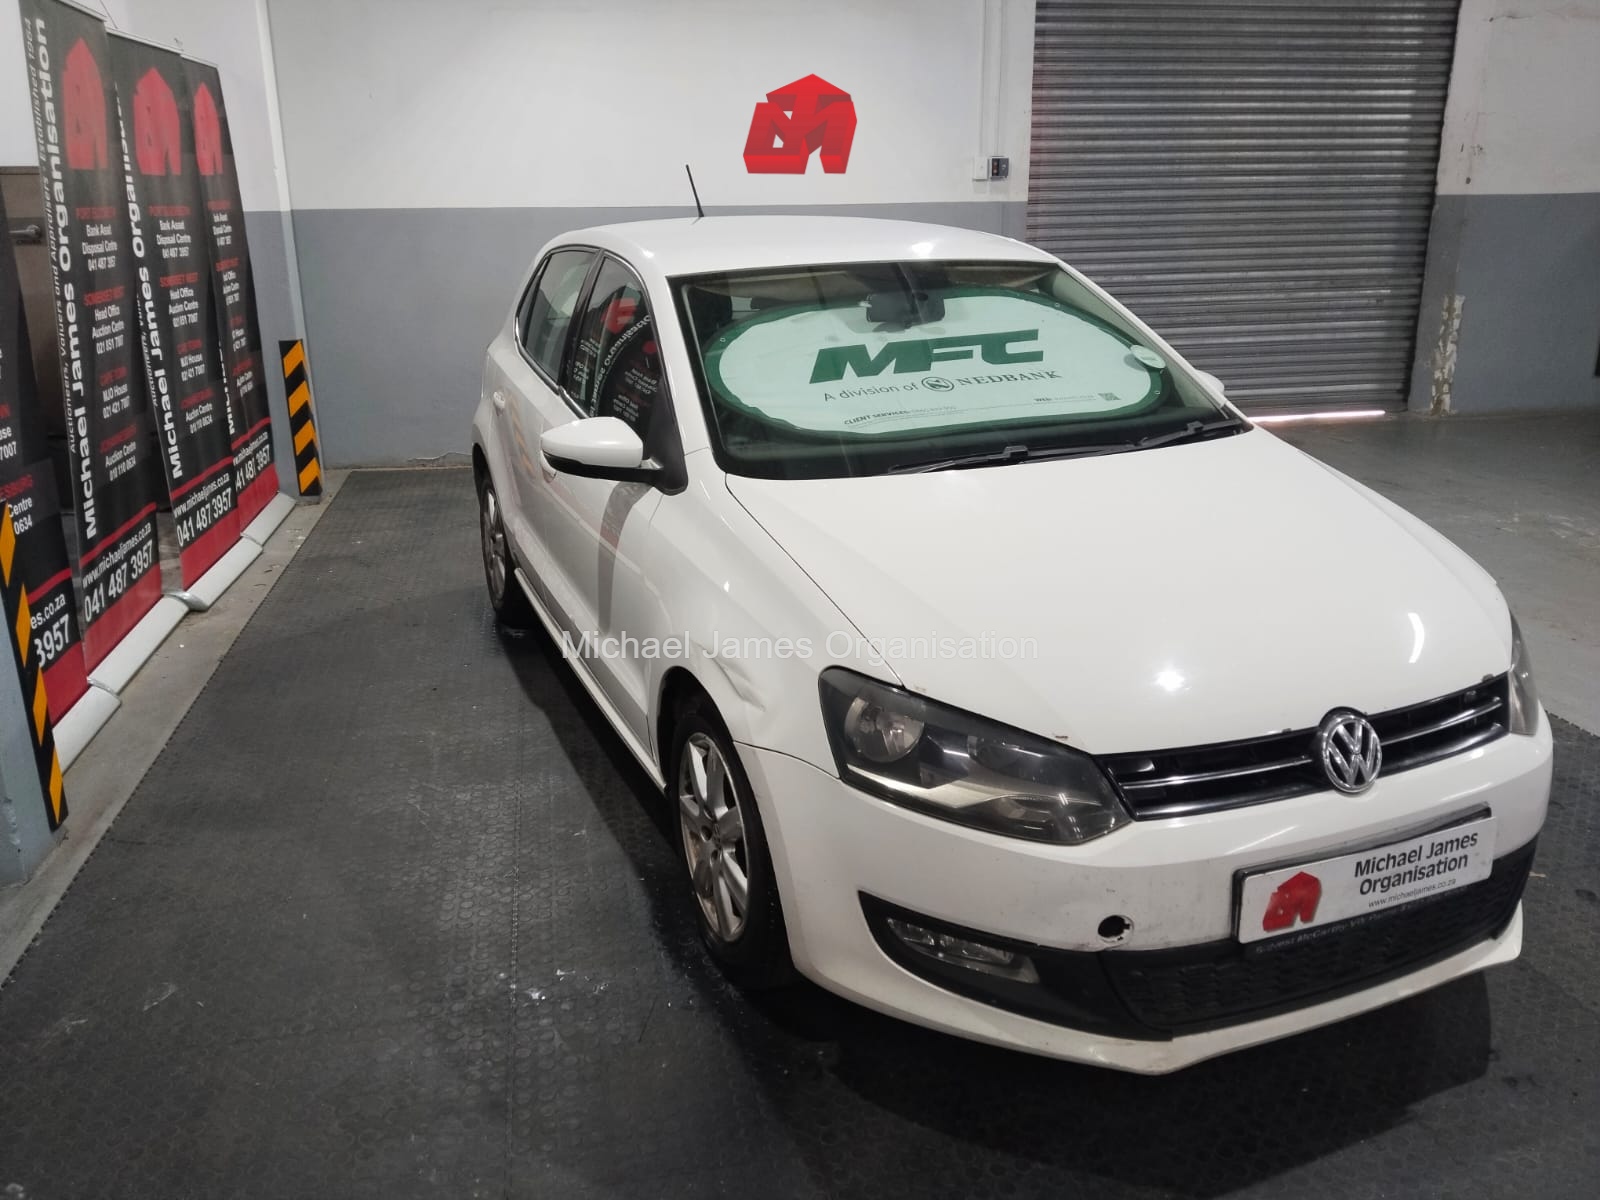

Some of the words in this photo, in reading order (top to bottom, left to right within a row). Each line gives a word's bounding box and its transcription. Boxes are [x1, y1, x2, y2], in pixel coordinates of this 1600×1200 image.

[35, 18, 71, 272] Organisation
[43, 176, 57, 262] Appraisers
[51, 266, 60, 296] and
[56, 301, 67, 357] Valuers
[63, 282, 84, 397] James
[139, 267, 163, 361] James
[809, 329, 1044, 384] MFC
[824, 392, 836, 402] A
[839, 383, 899, 400] division
[903, 382, 919, 393] of
[958, 371, 1062, 386] NEDBANK
[154, 368, 183, 479] Michael
[73, 407, 97, 540] Michael
[176, 516, 195, 547] 041
[196, 503, 212, 532] 487
[211, 487, 232, 519] 3957
[84, 582, 105, 622] 041
[108, 562, 127, 598] 487
[130, 539, 153, 579] 3957
[34, 613, 70, 668] 3957
[1354, 845, 1423, 878] Michael
[1426, 832, 1478, 860] James
[1359, 853, 1468, 895] Organisation
